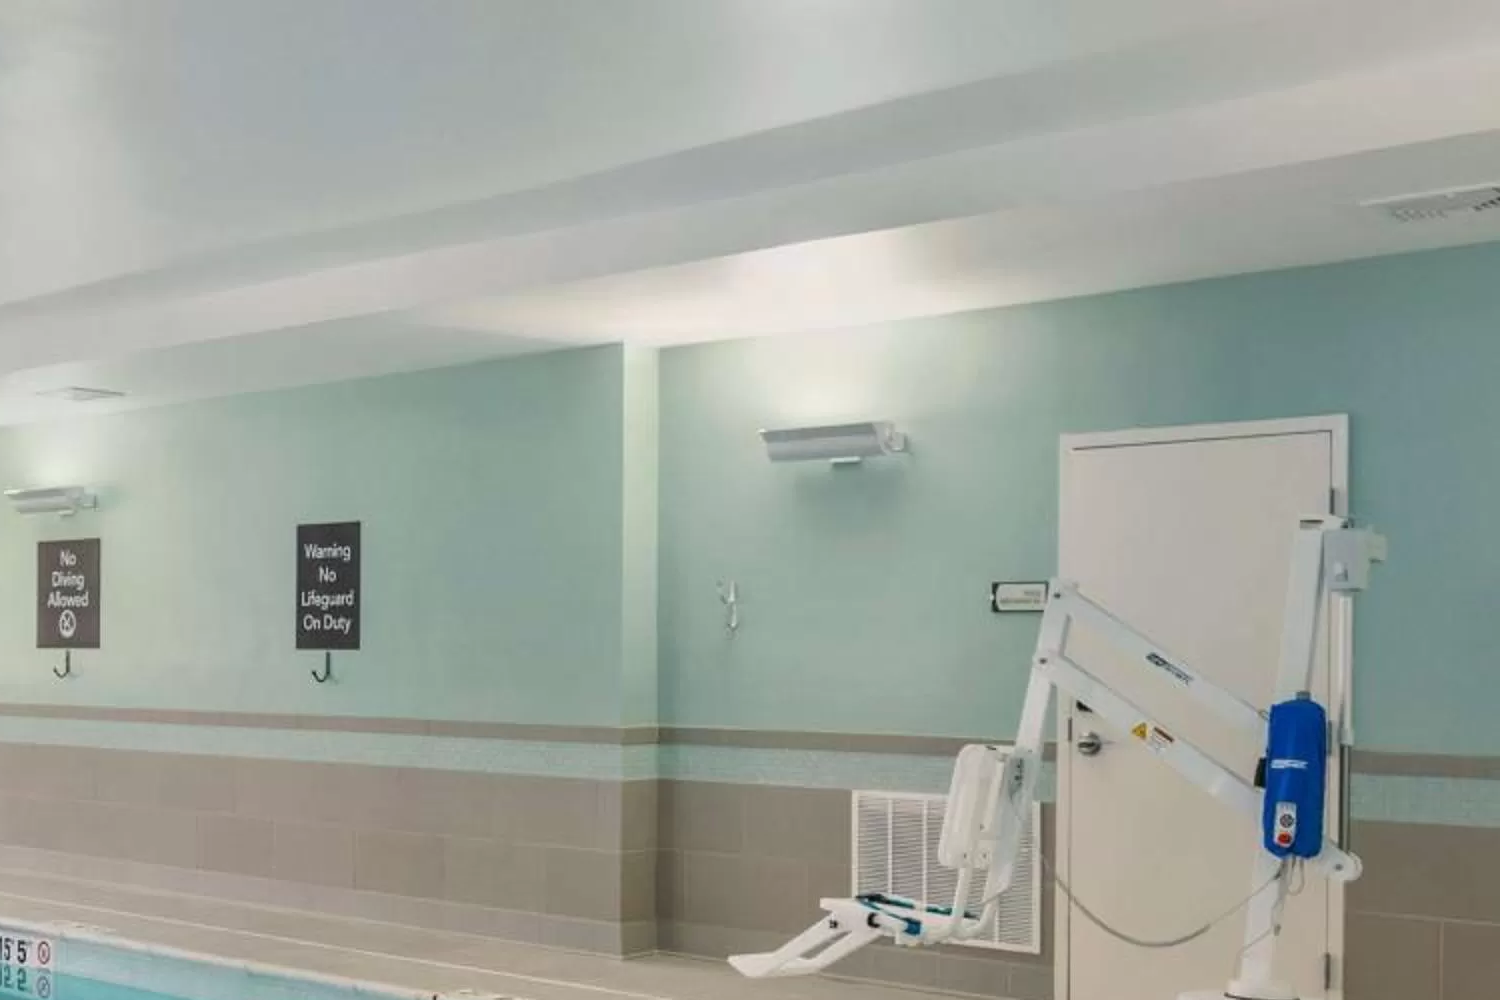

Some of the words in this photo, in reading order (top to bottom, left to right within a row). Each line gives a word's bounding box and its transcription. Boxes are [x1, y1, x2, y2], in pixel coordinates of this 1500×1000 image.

[60, 550, 77, 567] No
[303, 543, 351, 561] Warning
[51, 571, 85, 591] Diving
[319, 566, 337, 583] No
[47, 591, 89, 608] Allowed
[301, 589, 355, 610] Lifeguard
[303, 614, 321, 630] On
[323, 614, 351, 635] Duty
